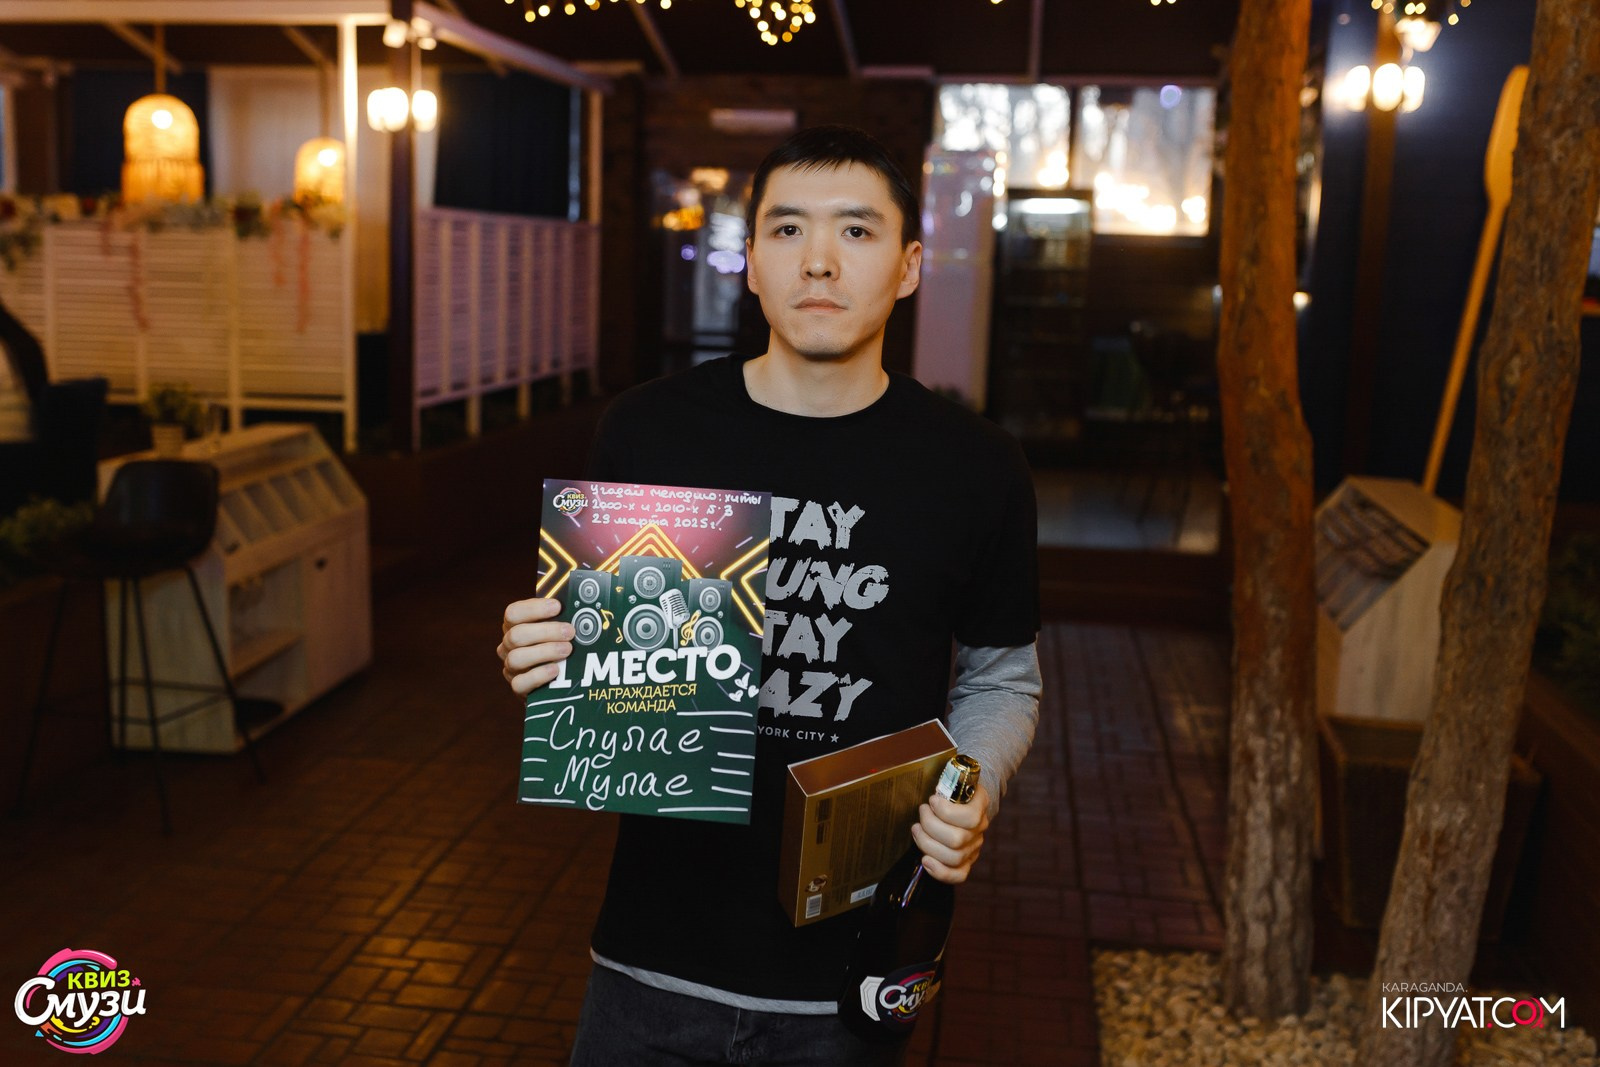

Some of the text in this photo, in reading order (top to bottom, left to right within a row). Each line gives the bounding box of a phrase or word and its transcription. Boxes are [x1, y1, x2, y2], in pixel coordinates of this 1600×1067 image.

[552, 494, 589, 509] Смузи
[590, 484, 645, 498] Угадай
[724, 492, 762, 505] хиты
[641, 503, 651, 512] и
[592, 513, 611, 525] 29
[614, 514, 669, 529] марта
[580, 644, 742, 688] МЕСТО
[588, 683, 698, 701] НАГРАЖДАЕТСЯ
[606, 699, 677, 714] КОМАНДА
[549, 705, 704, 769] Спулае
[757, 725, 825, 742] YORK CITY
[553, 754, 694, 811] Мулае
[879, 984, 927, 1011] Сму
